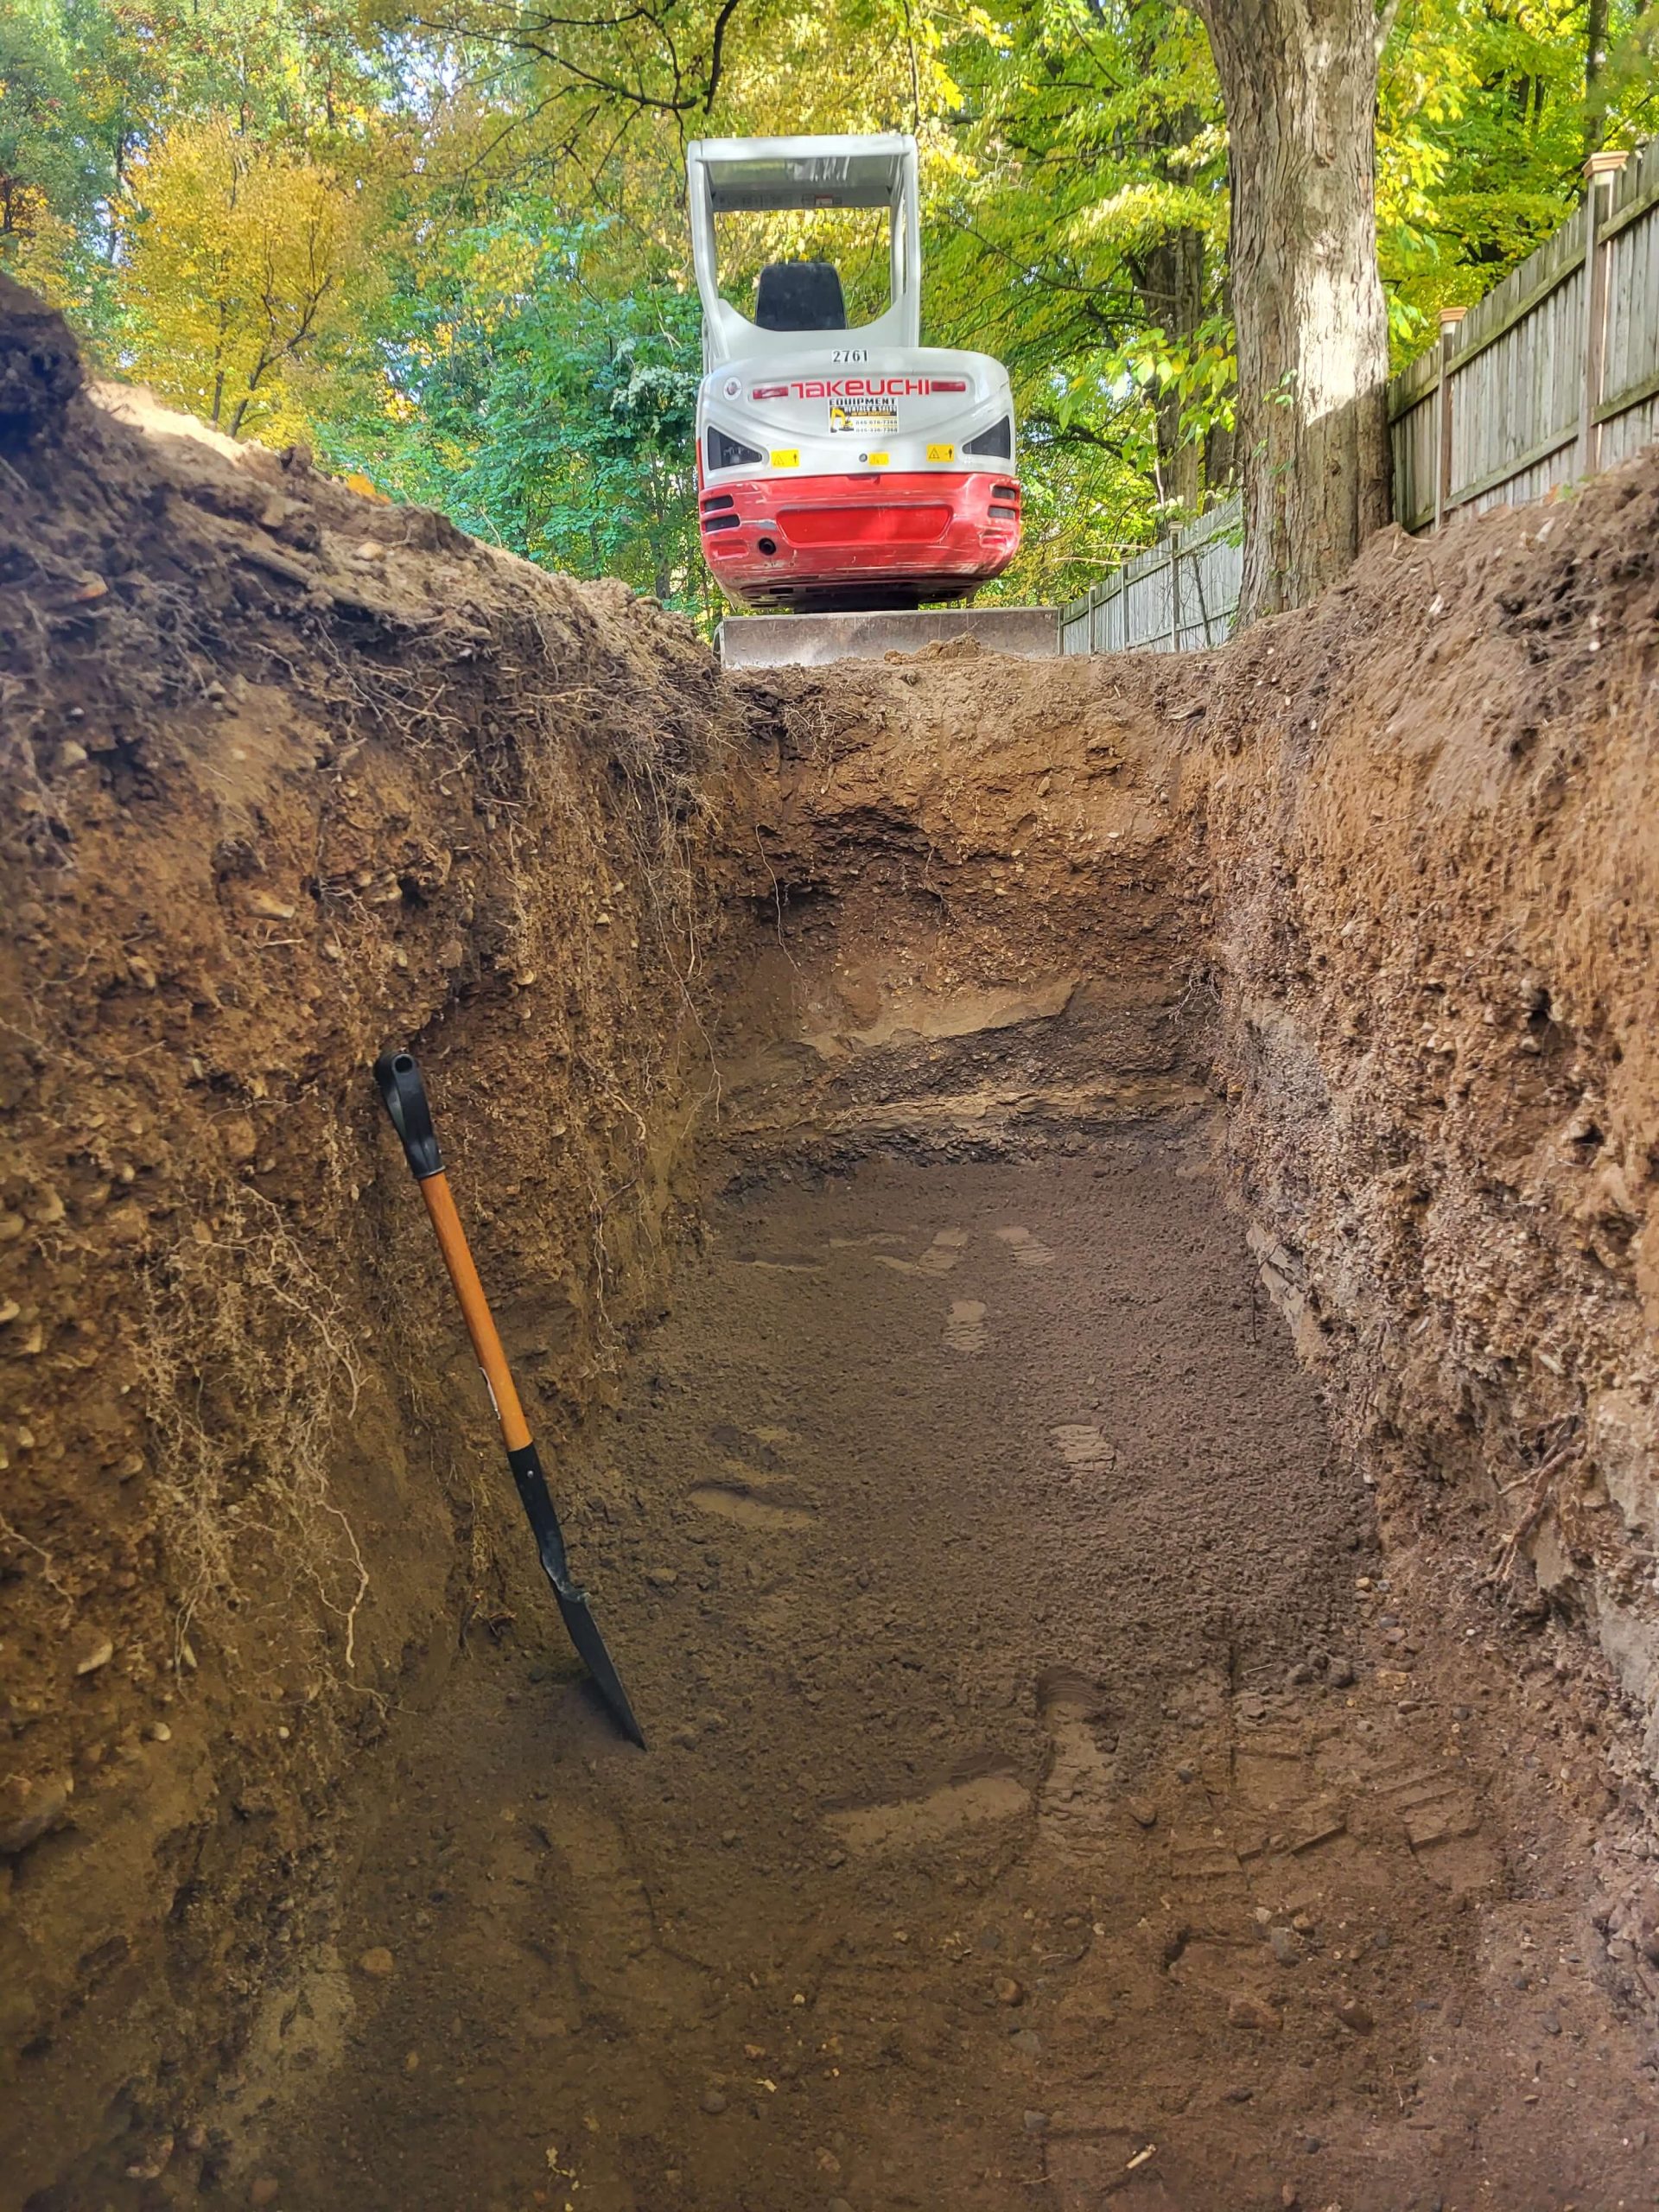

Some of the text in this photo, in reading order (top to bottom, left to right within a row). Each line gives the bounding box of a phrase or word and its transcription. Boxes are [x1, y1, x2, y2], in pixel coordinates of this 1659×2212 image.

[833, 350, 868, 363] 2761
[791, 378, 931, 399] TAKEUCHI
[829, 397, 895, 406] EQUIPMENT
